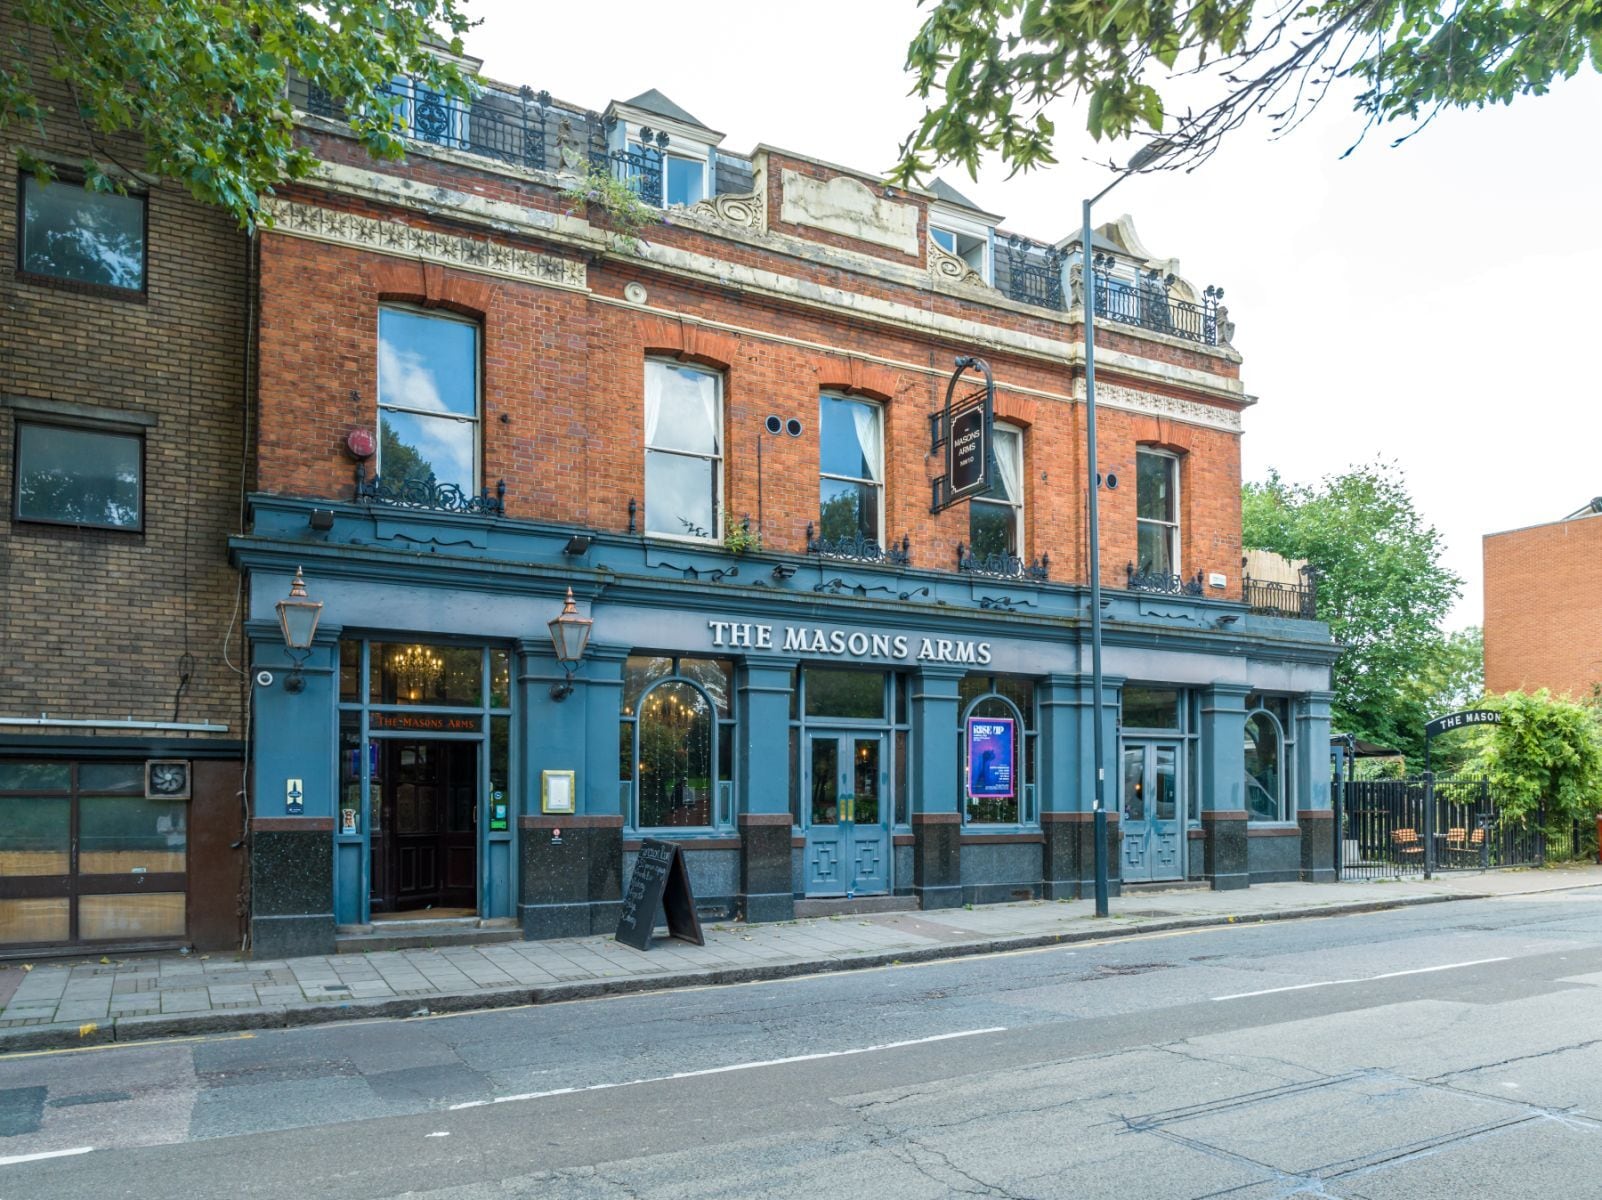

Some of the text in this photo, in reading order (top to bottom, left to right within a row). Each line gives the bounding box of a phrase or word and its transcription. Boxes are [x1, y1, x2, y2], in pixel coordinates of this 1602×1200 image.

[954, 429, 980, 448] MASONS
[958, 442, 976, 456] ARMS
[708, 620, 993, 665] THE MASONS ARMS
[377, 715, 475, 729] THE MASONS ARMS
[1440, 715, 1462, 730] THE
